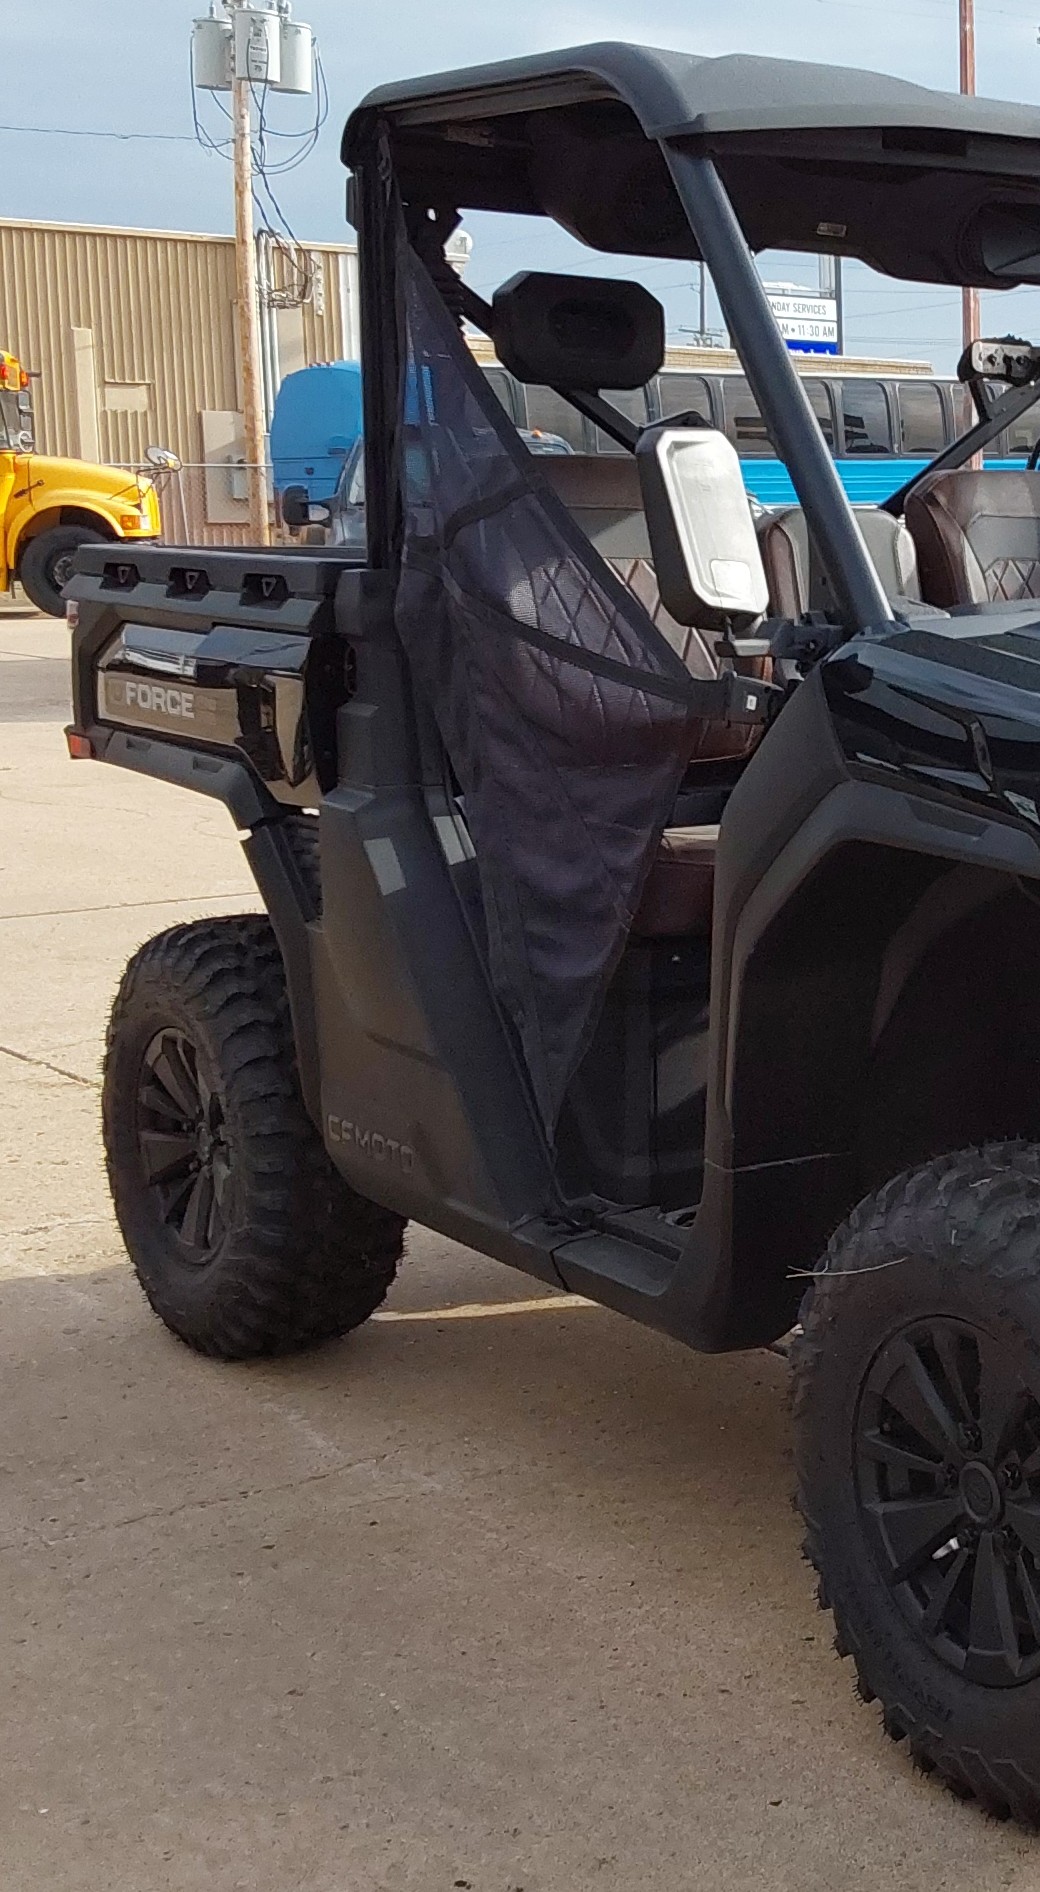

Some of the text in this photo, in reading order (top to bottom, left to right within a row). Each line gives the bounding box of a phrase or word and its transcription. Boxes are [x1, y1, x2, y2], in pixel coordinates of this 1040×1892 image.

[771, 302, 827, 316] NDAY SERVICES
[798, 325, 820, 337] 11:30
[823, 327, 835, 337] AM
[327, 1114, 415, 1174] CFMOTO
